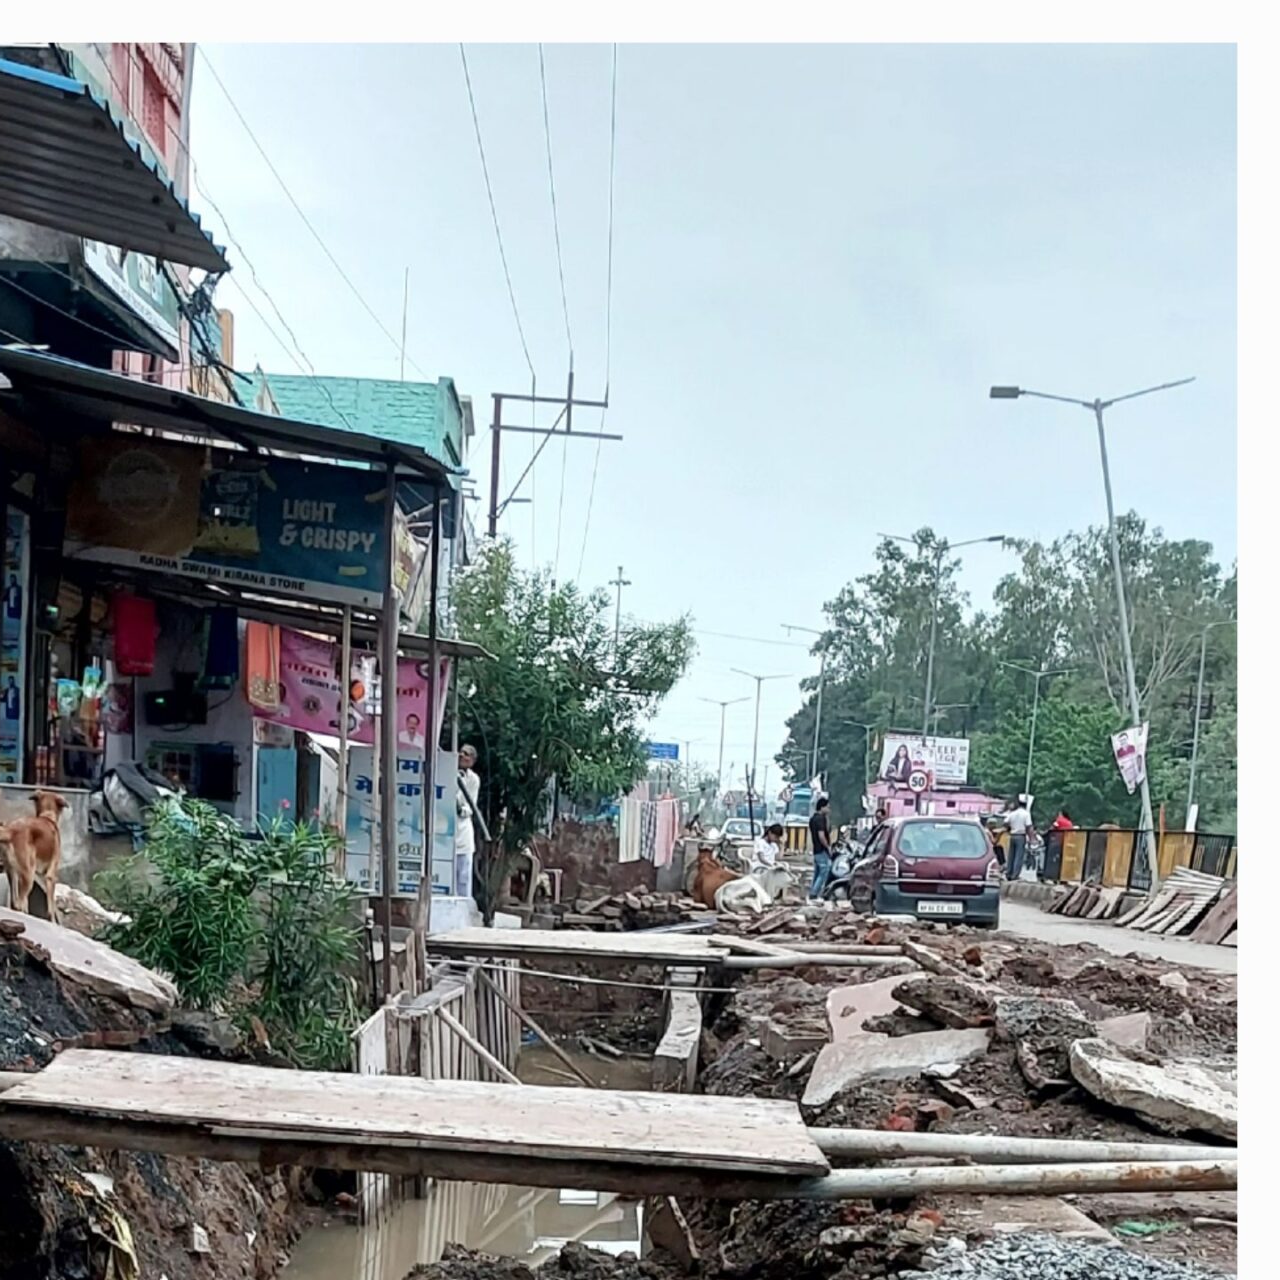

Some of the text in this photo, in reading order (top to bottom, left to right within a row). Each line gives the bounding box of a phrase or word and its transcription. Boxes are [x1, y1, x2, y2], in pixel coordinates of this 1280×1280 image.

[282, 498, 337, 523] LIGHT
[278, 523, 376, 553] & CRISPY
[139, 555, 306, 592] RADHA SWAMI KIRANA STORE
[910, 776, 926, 788] 50
